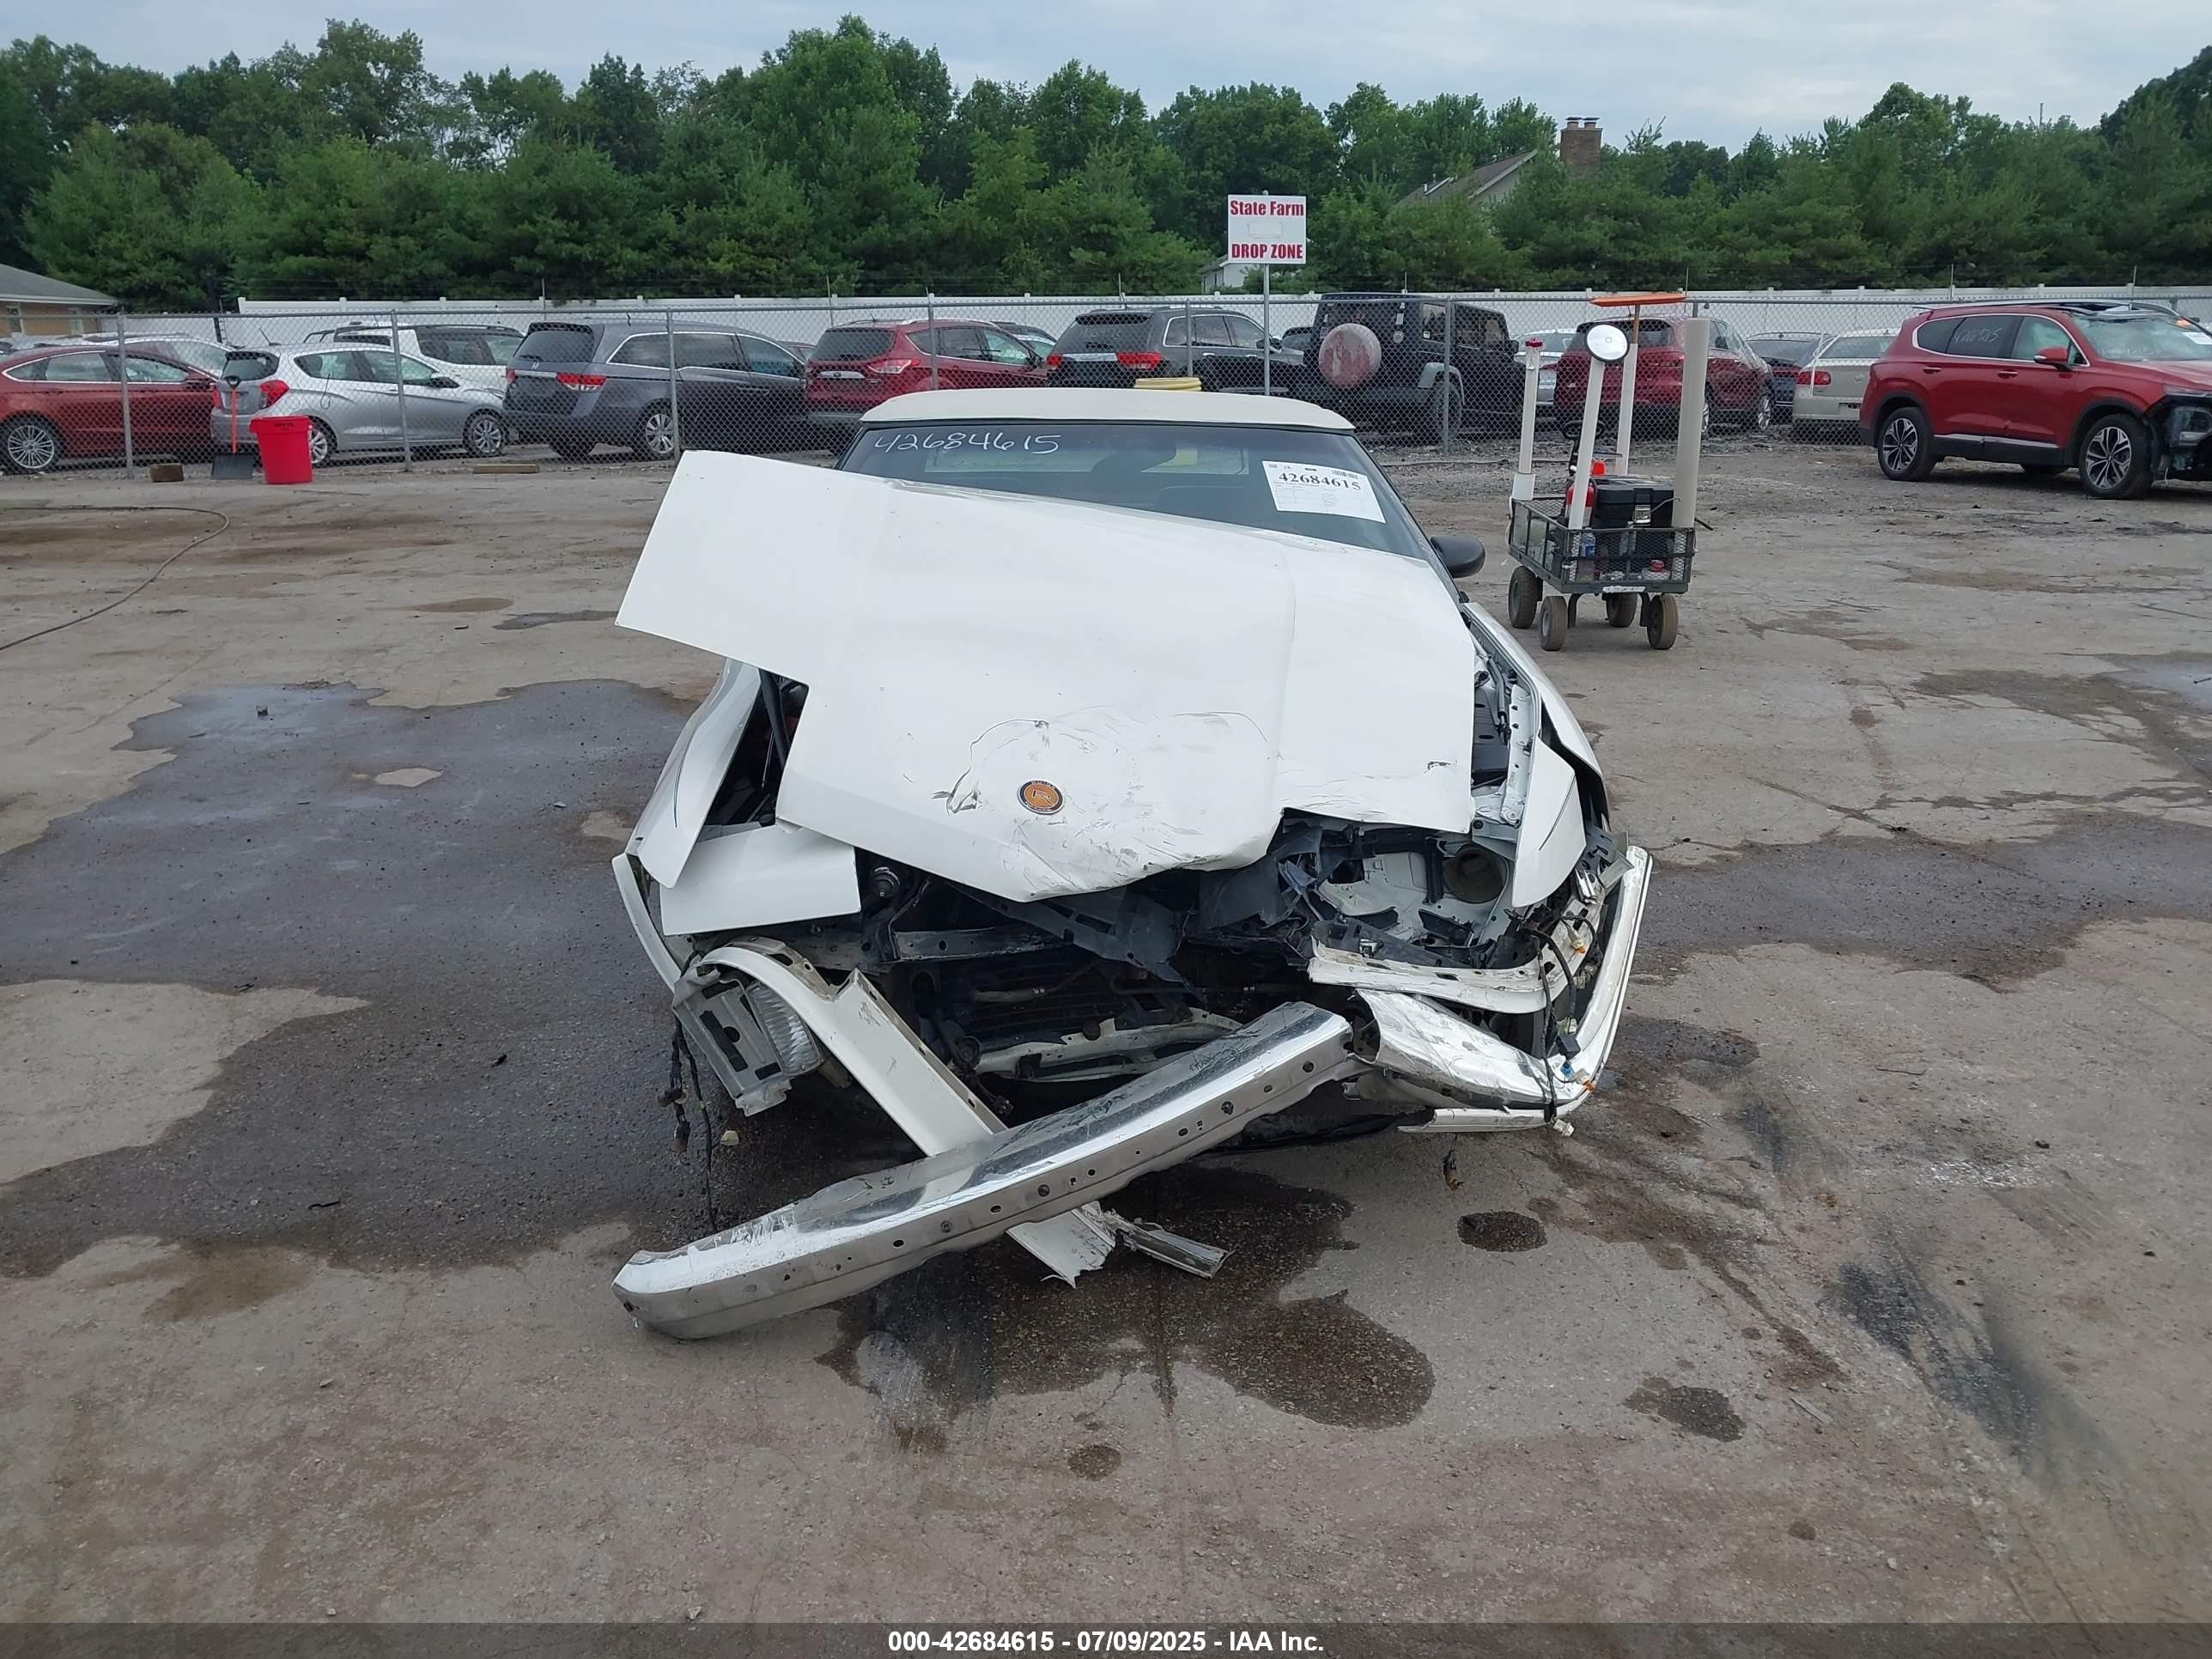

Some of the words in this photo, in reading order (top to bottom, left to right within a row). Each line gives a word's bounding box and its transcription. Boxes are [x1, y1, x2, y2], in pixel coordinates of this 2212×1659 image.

[1231, 200, 1267, 216] State
[1270, 201, 1304, 216] Farm
[1231, 243, 1267, 259] DROP
[1271, 244, 1304, 259] ZONE
[874, 432, 1061, 455] 42684615
[1278, 471, 1362, 491] 42684615
